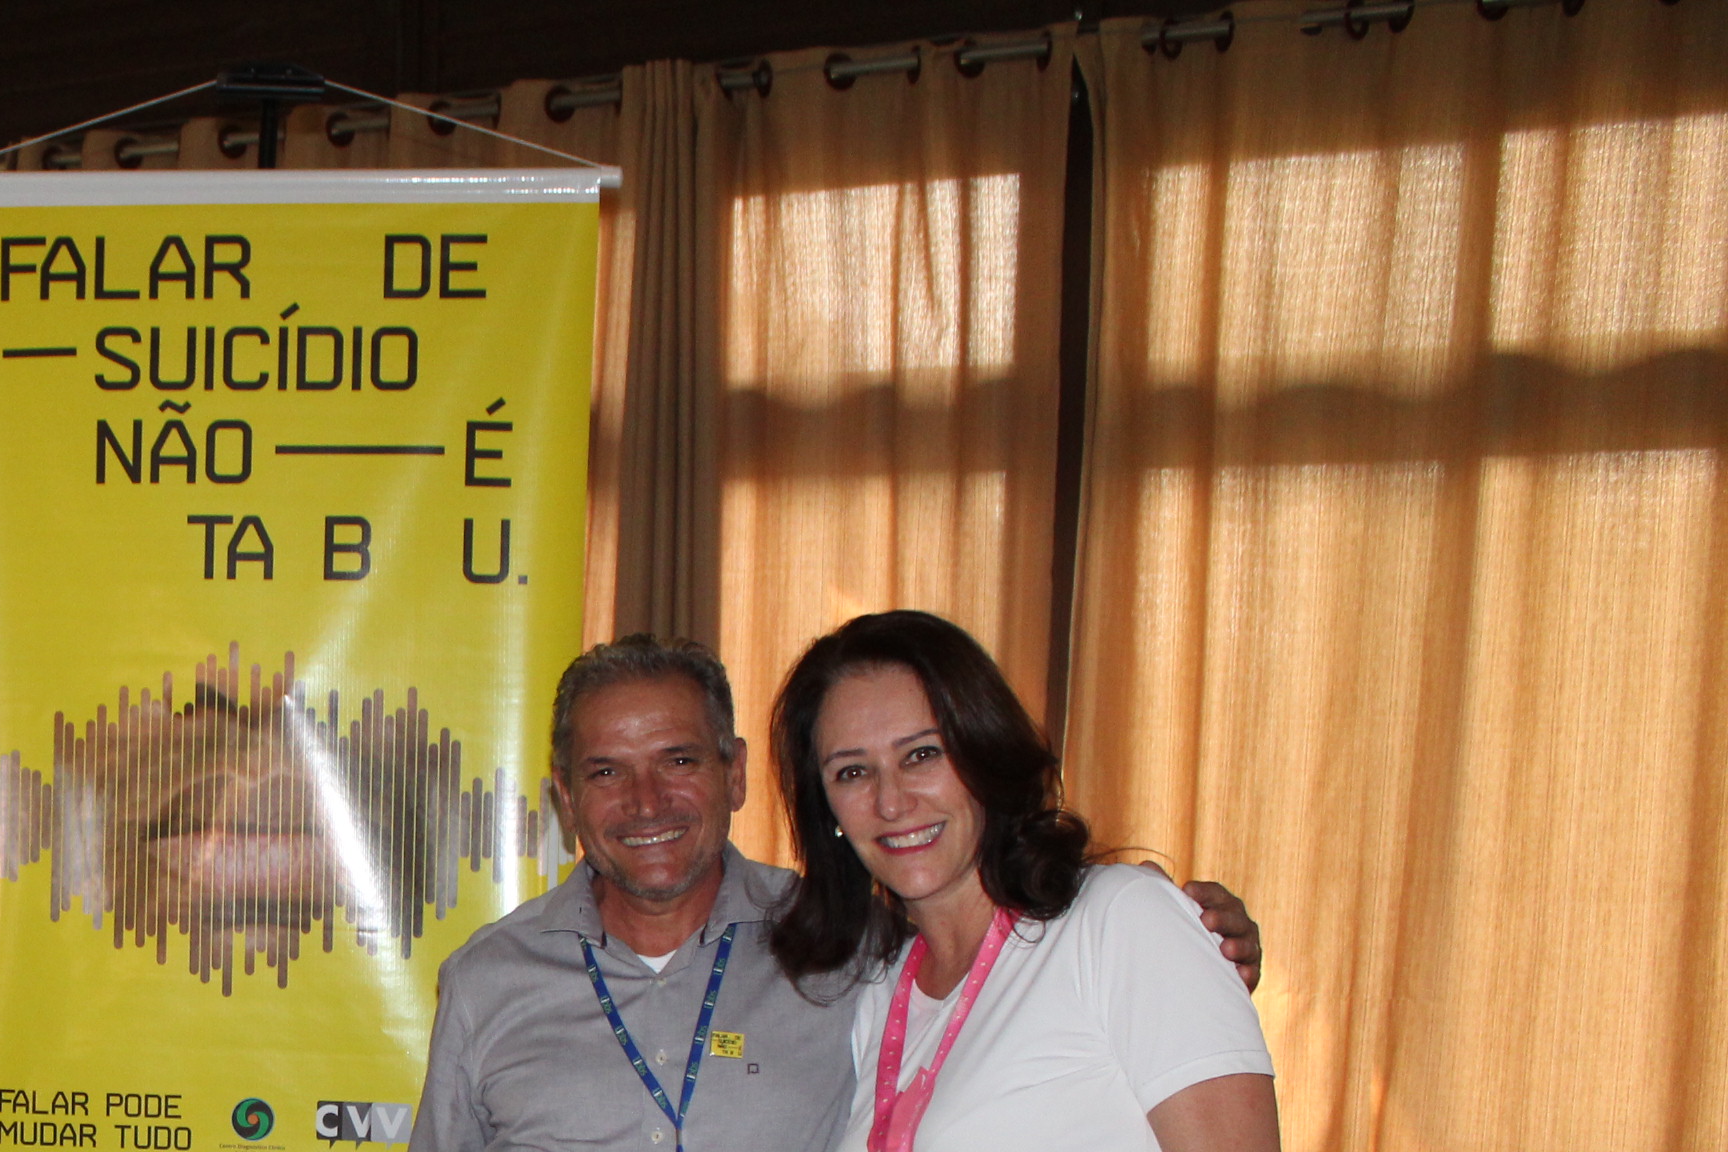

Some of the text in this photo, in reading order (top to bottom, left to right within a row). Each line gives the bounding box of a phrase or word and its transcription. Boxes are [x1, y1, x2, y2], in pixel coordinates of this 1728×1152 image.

[0, 233, 488, 301] FALAR DE
[94, 302, 419, 391] SUICÍDIO
[96, 397, 514, 487] NÃO É
[106, 1093, 182, 1119] PODE
[316, 1103, 409, 1140] CVV
[114, 1124, 192, 1151] TUDO
